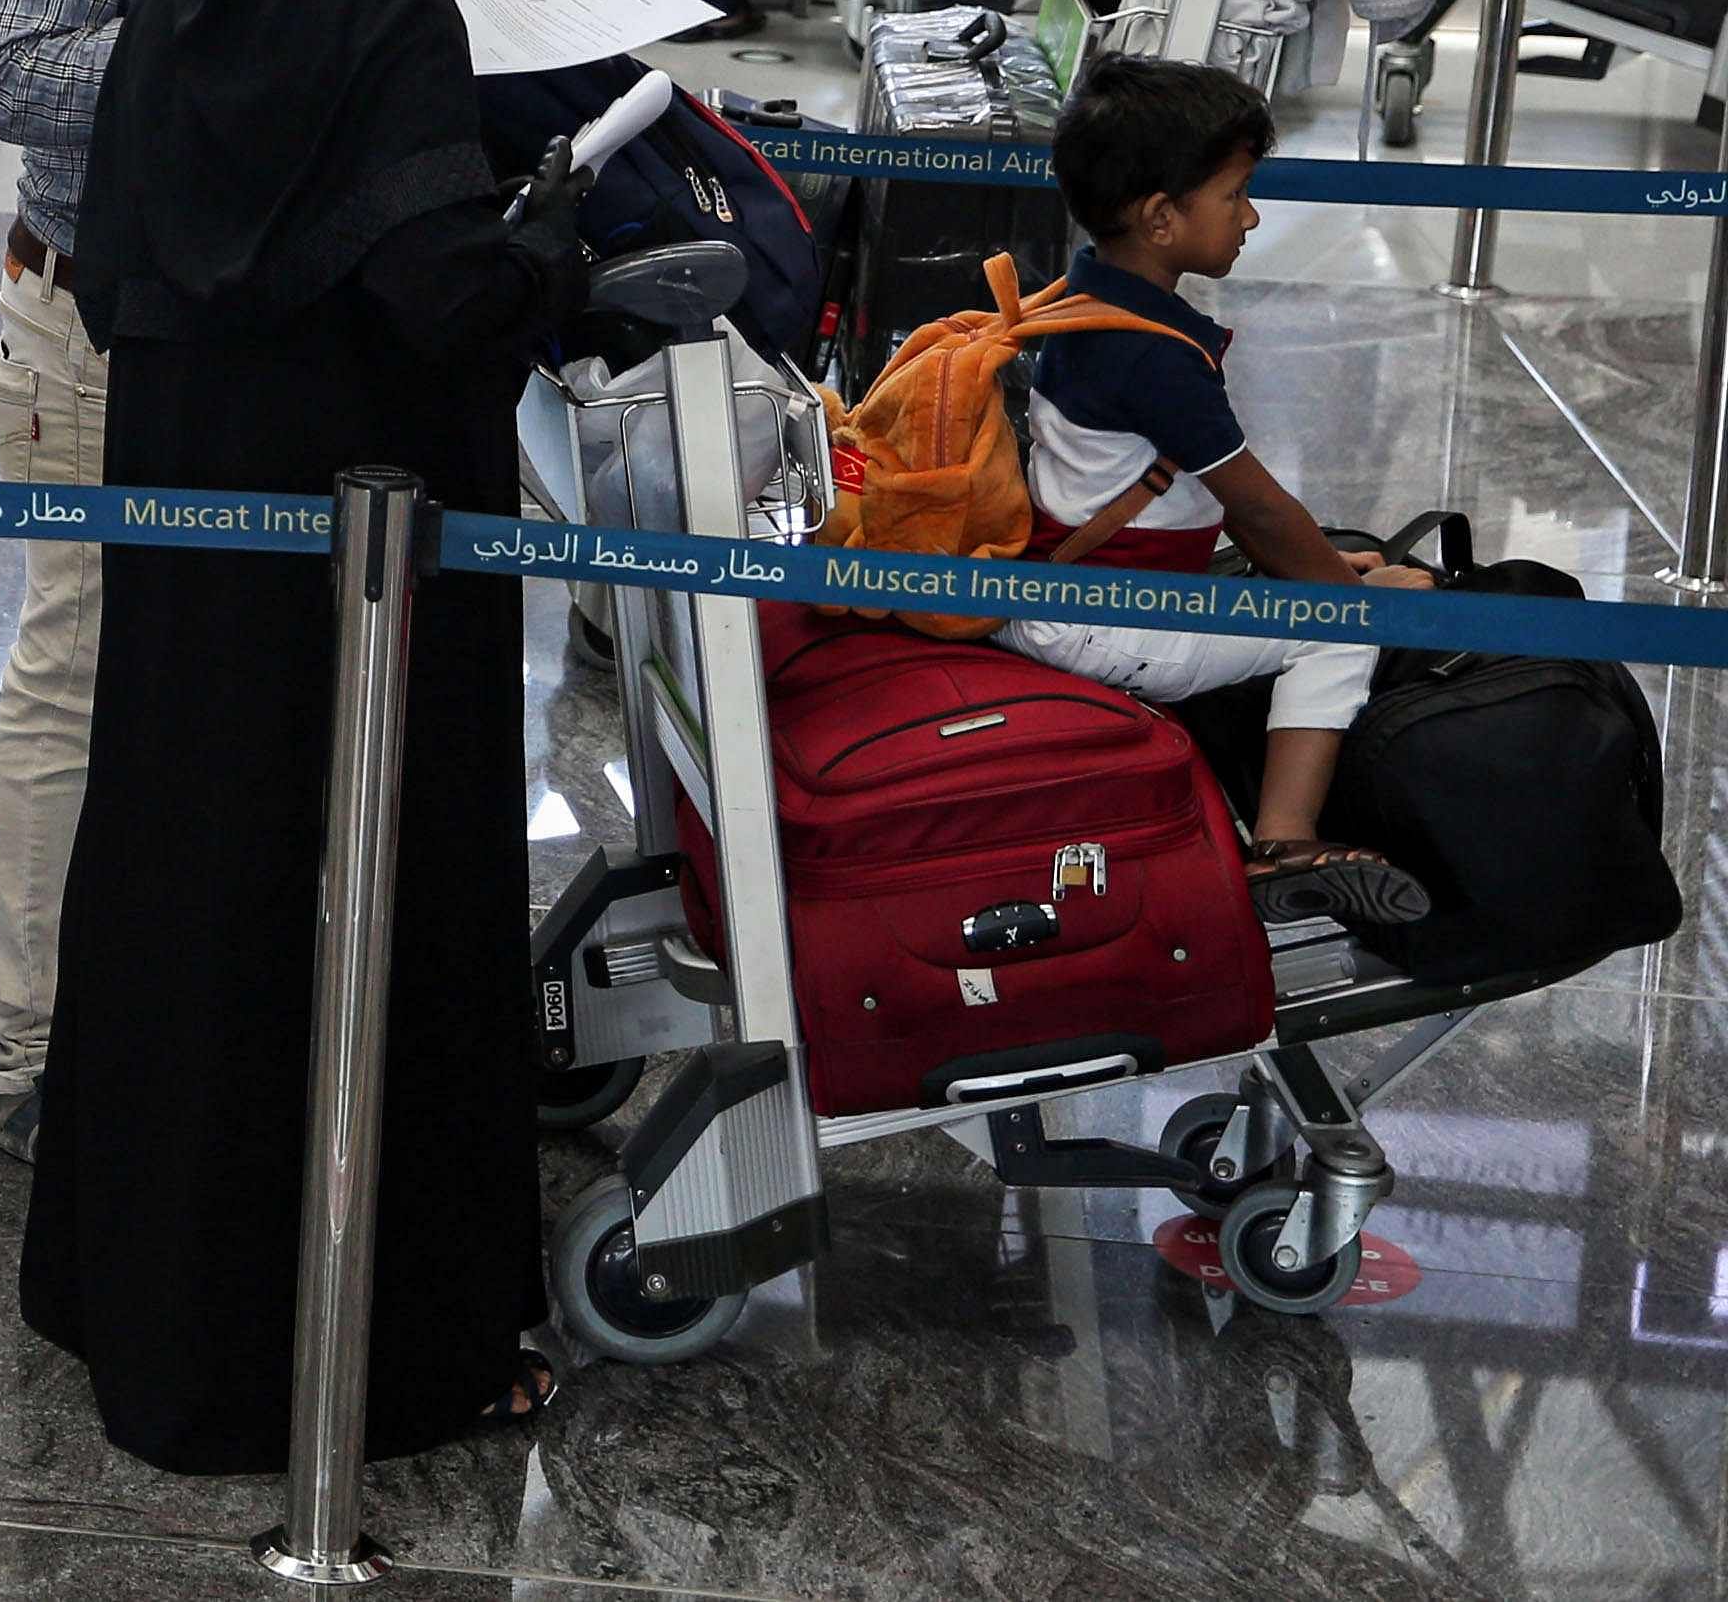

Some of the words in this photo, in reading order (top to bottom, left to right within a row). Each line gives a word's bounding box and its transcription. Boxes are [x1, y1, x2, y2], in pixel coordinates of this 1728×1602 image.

[750, 140, 802, 161] scat
[811, 140, 992, 171] International
[1002, 151, 1055, 181] Airp
[1646, 179, 1728, 209] لدولي
[18, 492, 85, 526] مطار
[125, 498, 249, 530] Muscat
[474, 531, 578, 564] الدولي
[590, 541, 698, 574] مسقط
[711, 549, 784, 583] مطار
[826, 559, 957, 594] Muscat
[970, 573, 1217, 615] International
[1231, 588, 1372, 628] Airport
